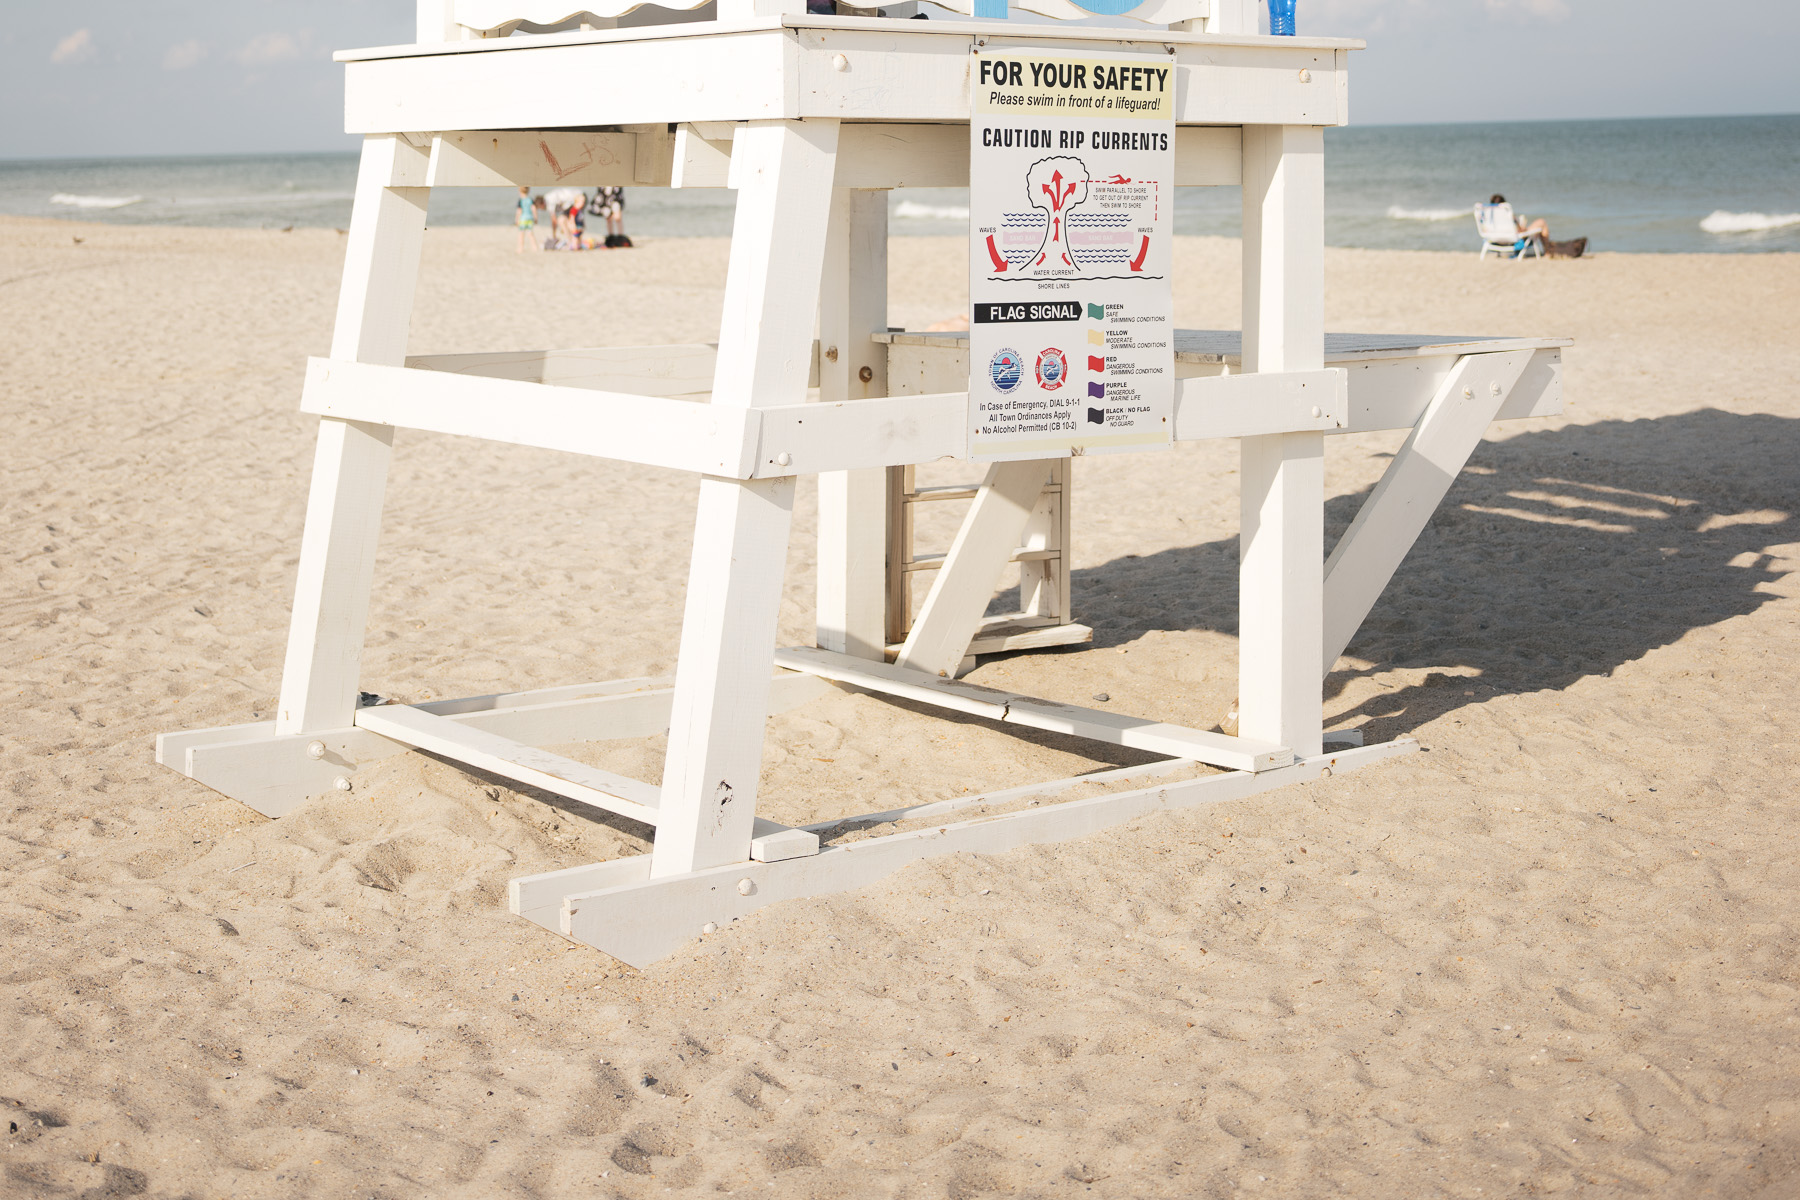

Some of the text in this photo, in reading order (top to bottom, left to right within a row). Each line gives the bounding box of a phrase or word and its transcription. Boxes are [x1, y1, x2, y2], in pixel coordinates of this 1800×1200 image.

[980, 60, 1168, 92] FOR YOUR SAFETY
[989, 91, 1161, 113] Please swim in front of a lifeguard!
[982, 127, 1168, 151] CAUTION RIP CURRENTS
[990, 304, 1077, 320] FLAG SIGNAL
[999, 347, 1020, 357] CAROLINA
[980, 402, 986, 411] In
[987, 402, 1003, 411] Case
[1004, 401, 1012, 410] of
[1049, 399, 1064, 408] DIAL
[1065, 398, 1080, 407] 9-1-1
[989, 410, 1071, 422] All Town Ordinances Apply
[982, 421, 1077, 434] No Alcohol Permitted (CB 10-2)
